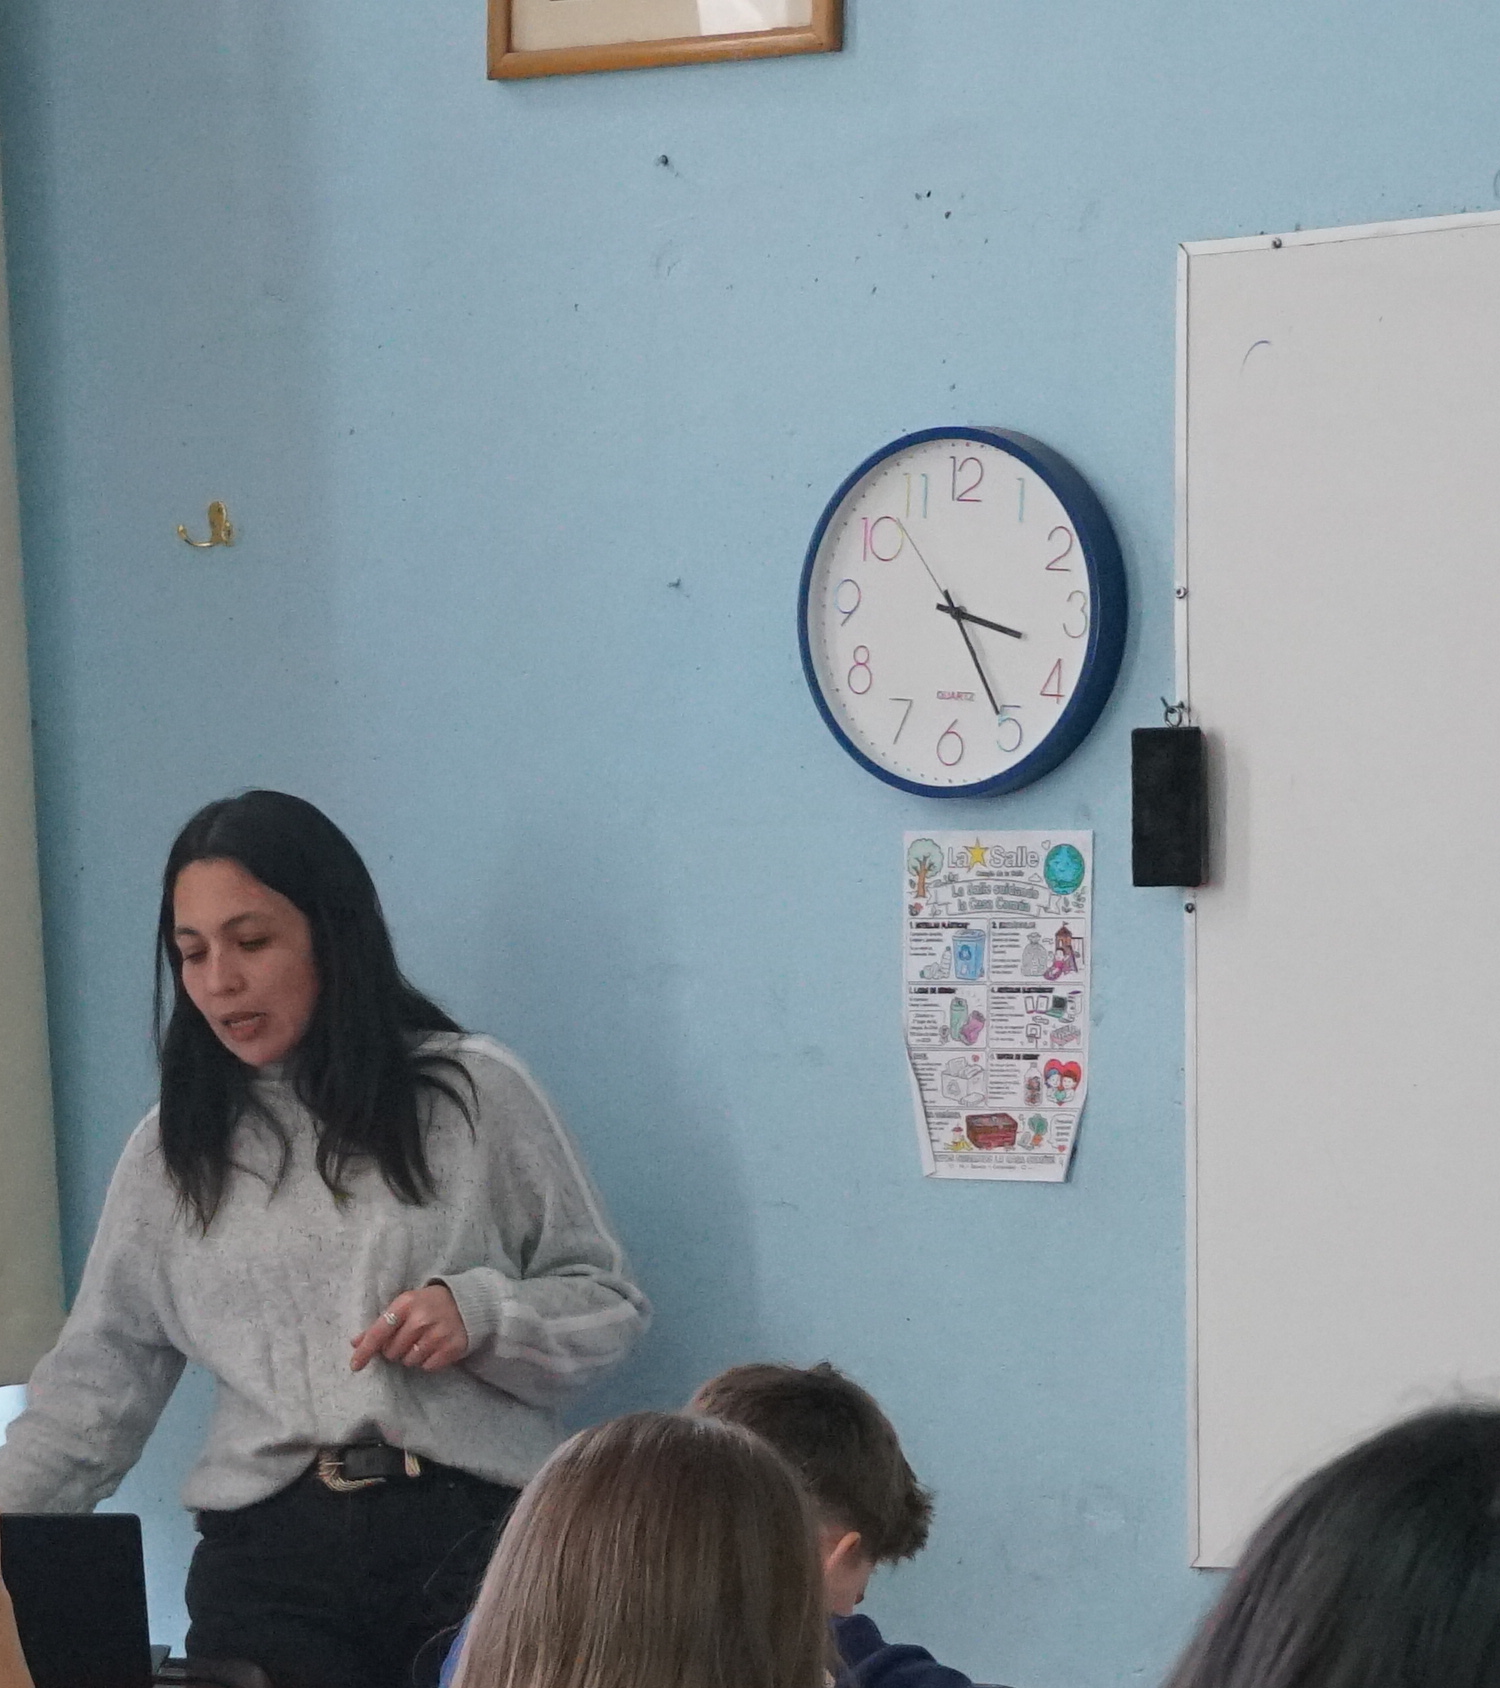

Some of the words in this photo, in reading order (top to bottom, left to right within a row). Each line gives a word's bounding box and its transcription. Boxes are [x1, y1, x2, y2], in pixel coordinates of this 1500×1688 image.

[903, 473, 928, 519] 11
[949, 455, 984, 503] 12
[1016, 477, 1026, 523] 1
[861, 515, 903, 562] 10
[1045, 525, 1074, 573] 2
[834, 578, 862, 628] 9
[1062, 589, 1089, 639] 3
[847, 644, 873, 695] 8
[1039, 657, 1066, 705] 4
[936, 690, 976, 702] QUARTZ
[889, 697, 914, 746] 7
[936, 718, 964, 766] 6
[996, 704, 1023, 753] 5
[947, 846, 969, 868] La
[989, 844, 1040, 868] Salle
